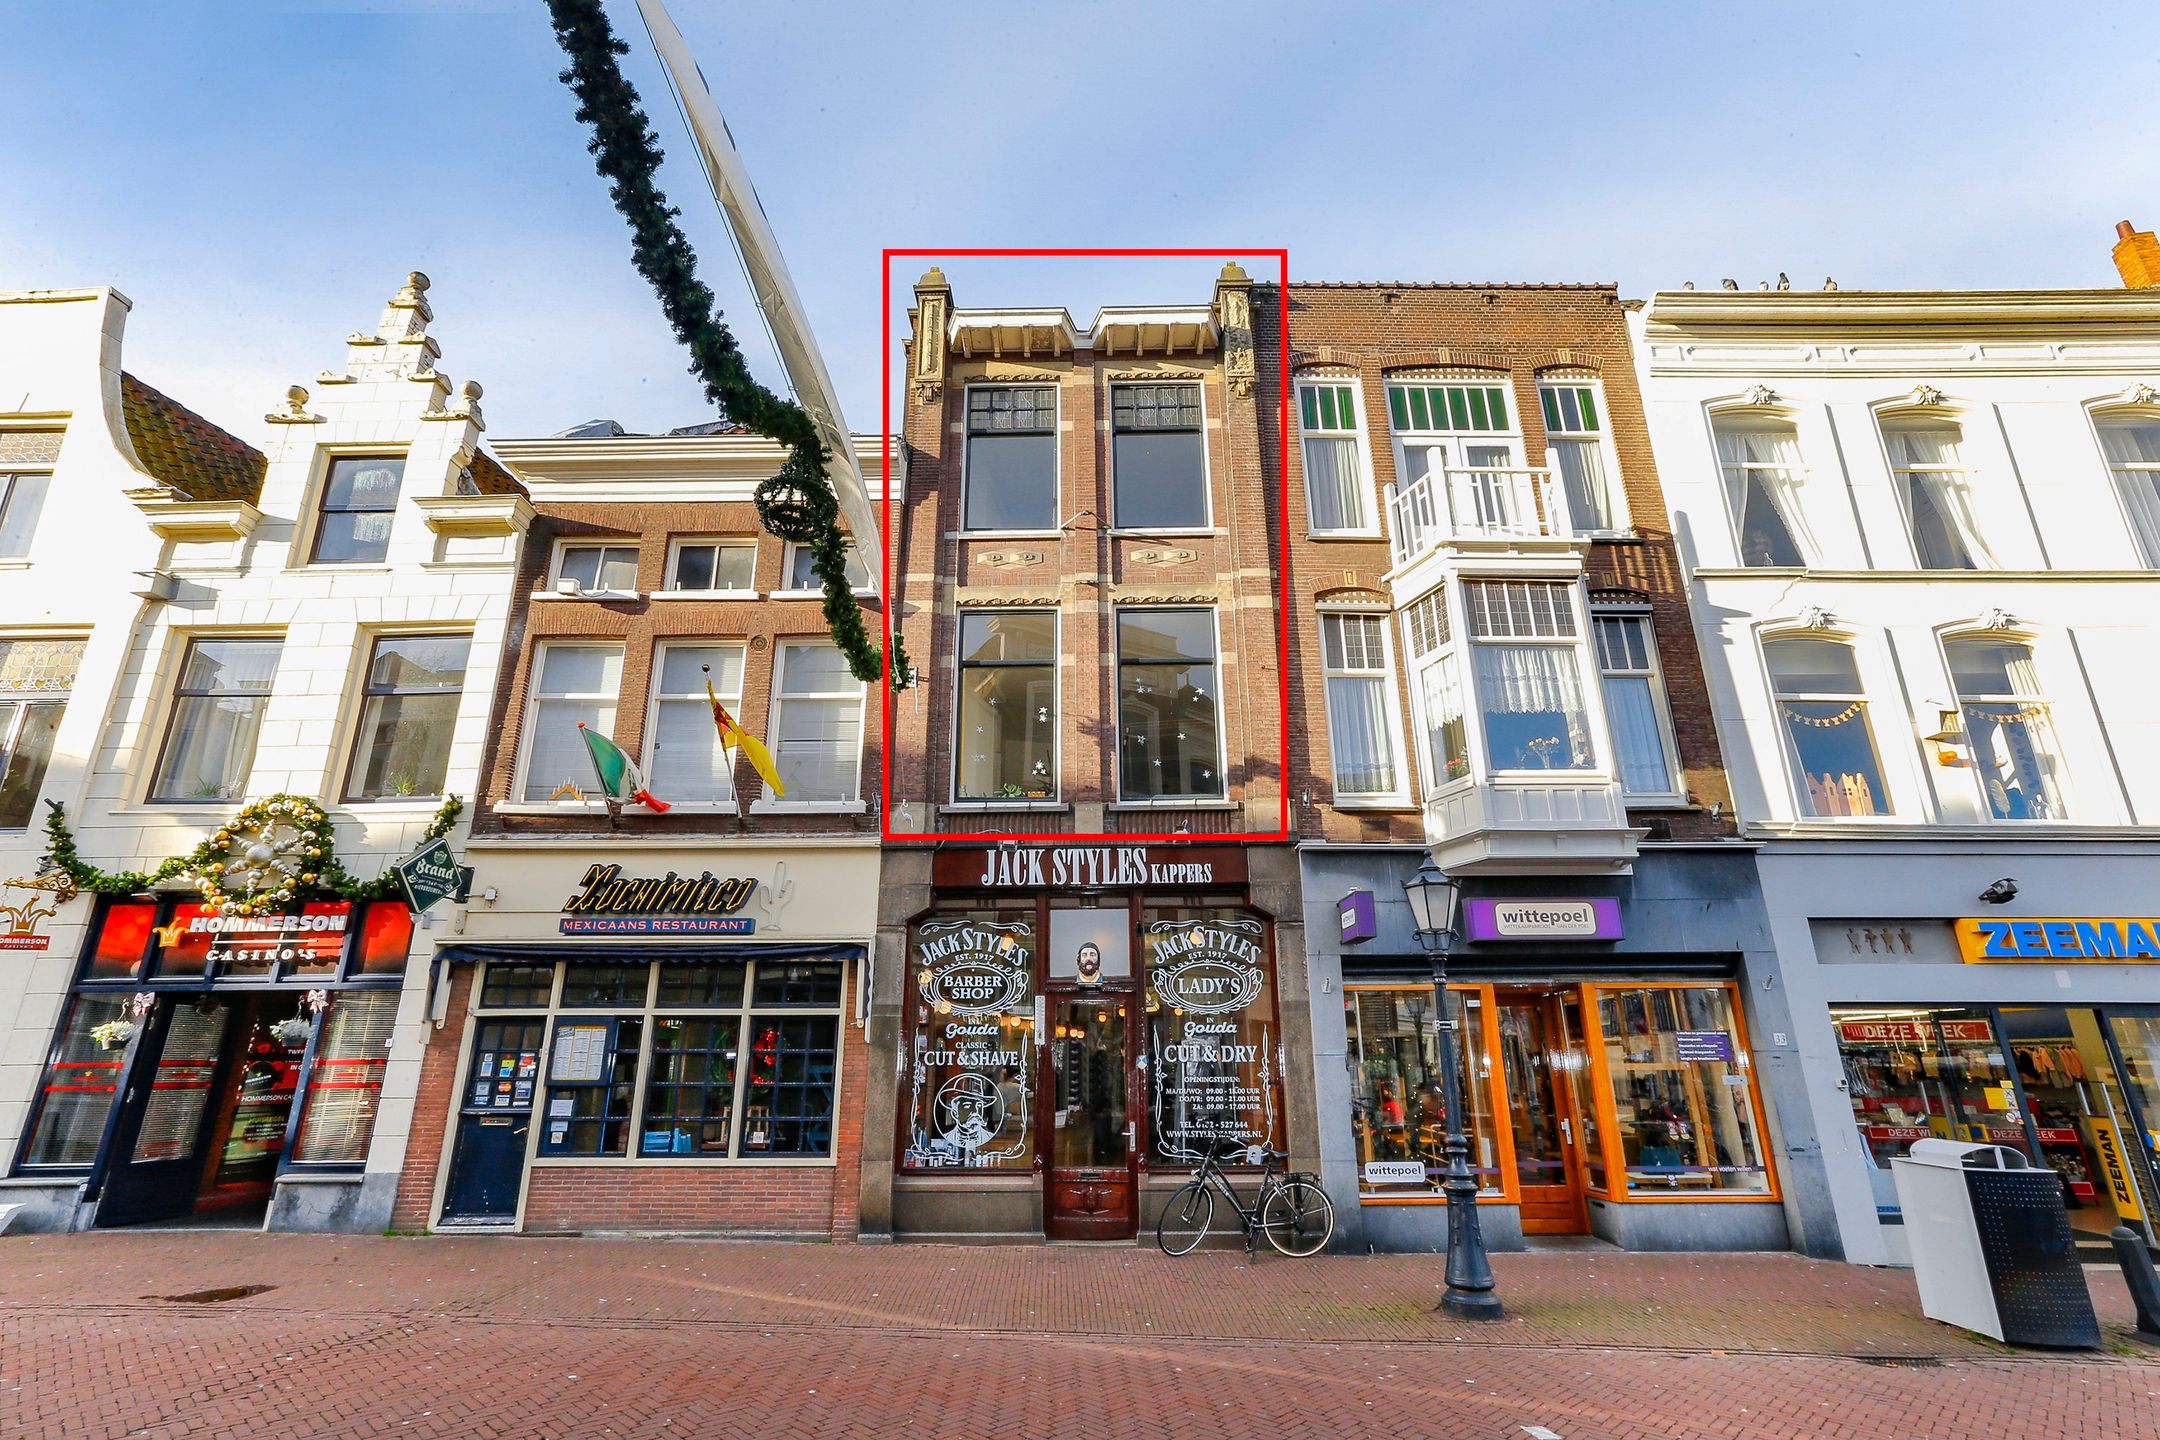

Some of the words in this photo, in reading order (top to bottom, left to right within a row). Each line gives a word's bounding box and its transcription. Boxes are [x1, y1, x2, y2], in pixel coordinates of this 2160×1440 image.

[416, 858, 455, 880] Brand
[981, 849, 1046, 886] JACK
[1053, 847, 1149, 885] STYLES
[1151, 863, 1213, 884] KAPPERS
[189, 914, 349, 933] HOMMERSON
[1502, 908, 1589, 926] wittepoel
[563, 920, 647, 930] MEXICAANS
[652, 920, 748, 930] RESTAURANT
[0, 937, 48, 945] OMMERSON
[920, 932, 961, 966] JACK
[962, 927, 1029, 966] STYLES
[1152, 930, 1194, 964] JACK
[1192, 925, 1262, 964] STYLES
[1978, 922, 2160, 957] ZEEMA
[206, 948, 318, 961] CASINO'S
[955, 953, 972, 961] EST.
[975, 952, 994, 961] 1917
[1187, 951, 1205, 960] EST.
[1208, 950, 1227, 960] 1917
[944, 975, 1003, 988] BARBER
[1177, 978, 1241, 994] LADY'S
[952, 988, 994, 999] SHOP
[945, 1023, 999, 1039] Gouda
[1184, 1021, 1238, 1038] Gouda
[1864, 1024, 1912, 1038] DEZE
[1915, 1024, 1967, 1038] WEK
[955, 1041, 988, 1049] CLASSIC
[1775, 1034, 1786, 1044] 33
[924, 1051, 956, 1066] CUT
[957, 1051, 969, 1066] &
[970, 1051, 1019, 1066] SHAVE
[1164, 1044, 1201, 1063] CUT
[1203, 1044, 1219, 1063] &
[1221, 1044, 1258, 1063] DRY
[1183, 1076, 1241, 1084] OPENINGSTIJDEN:
[1888, 1128, 1916, 1137] DEZE
[1992, 1129, 2023, 1138] DEZE
[2036, 1130, 2056, 1139] EEK
[1368, 1165, 1422, 1177] wittepoel
[2096, 1128, 2132, 1205] ZEEMAN
